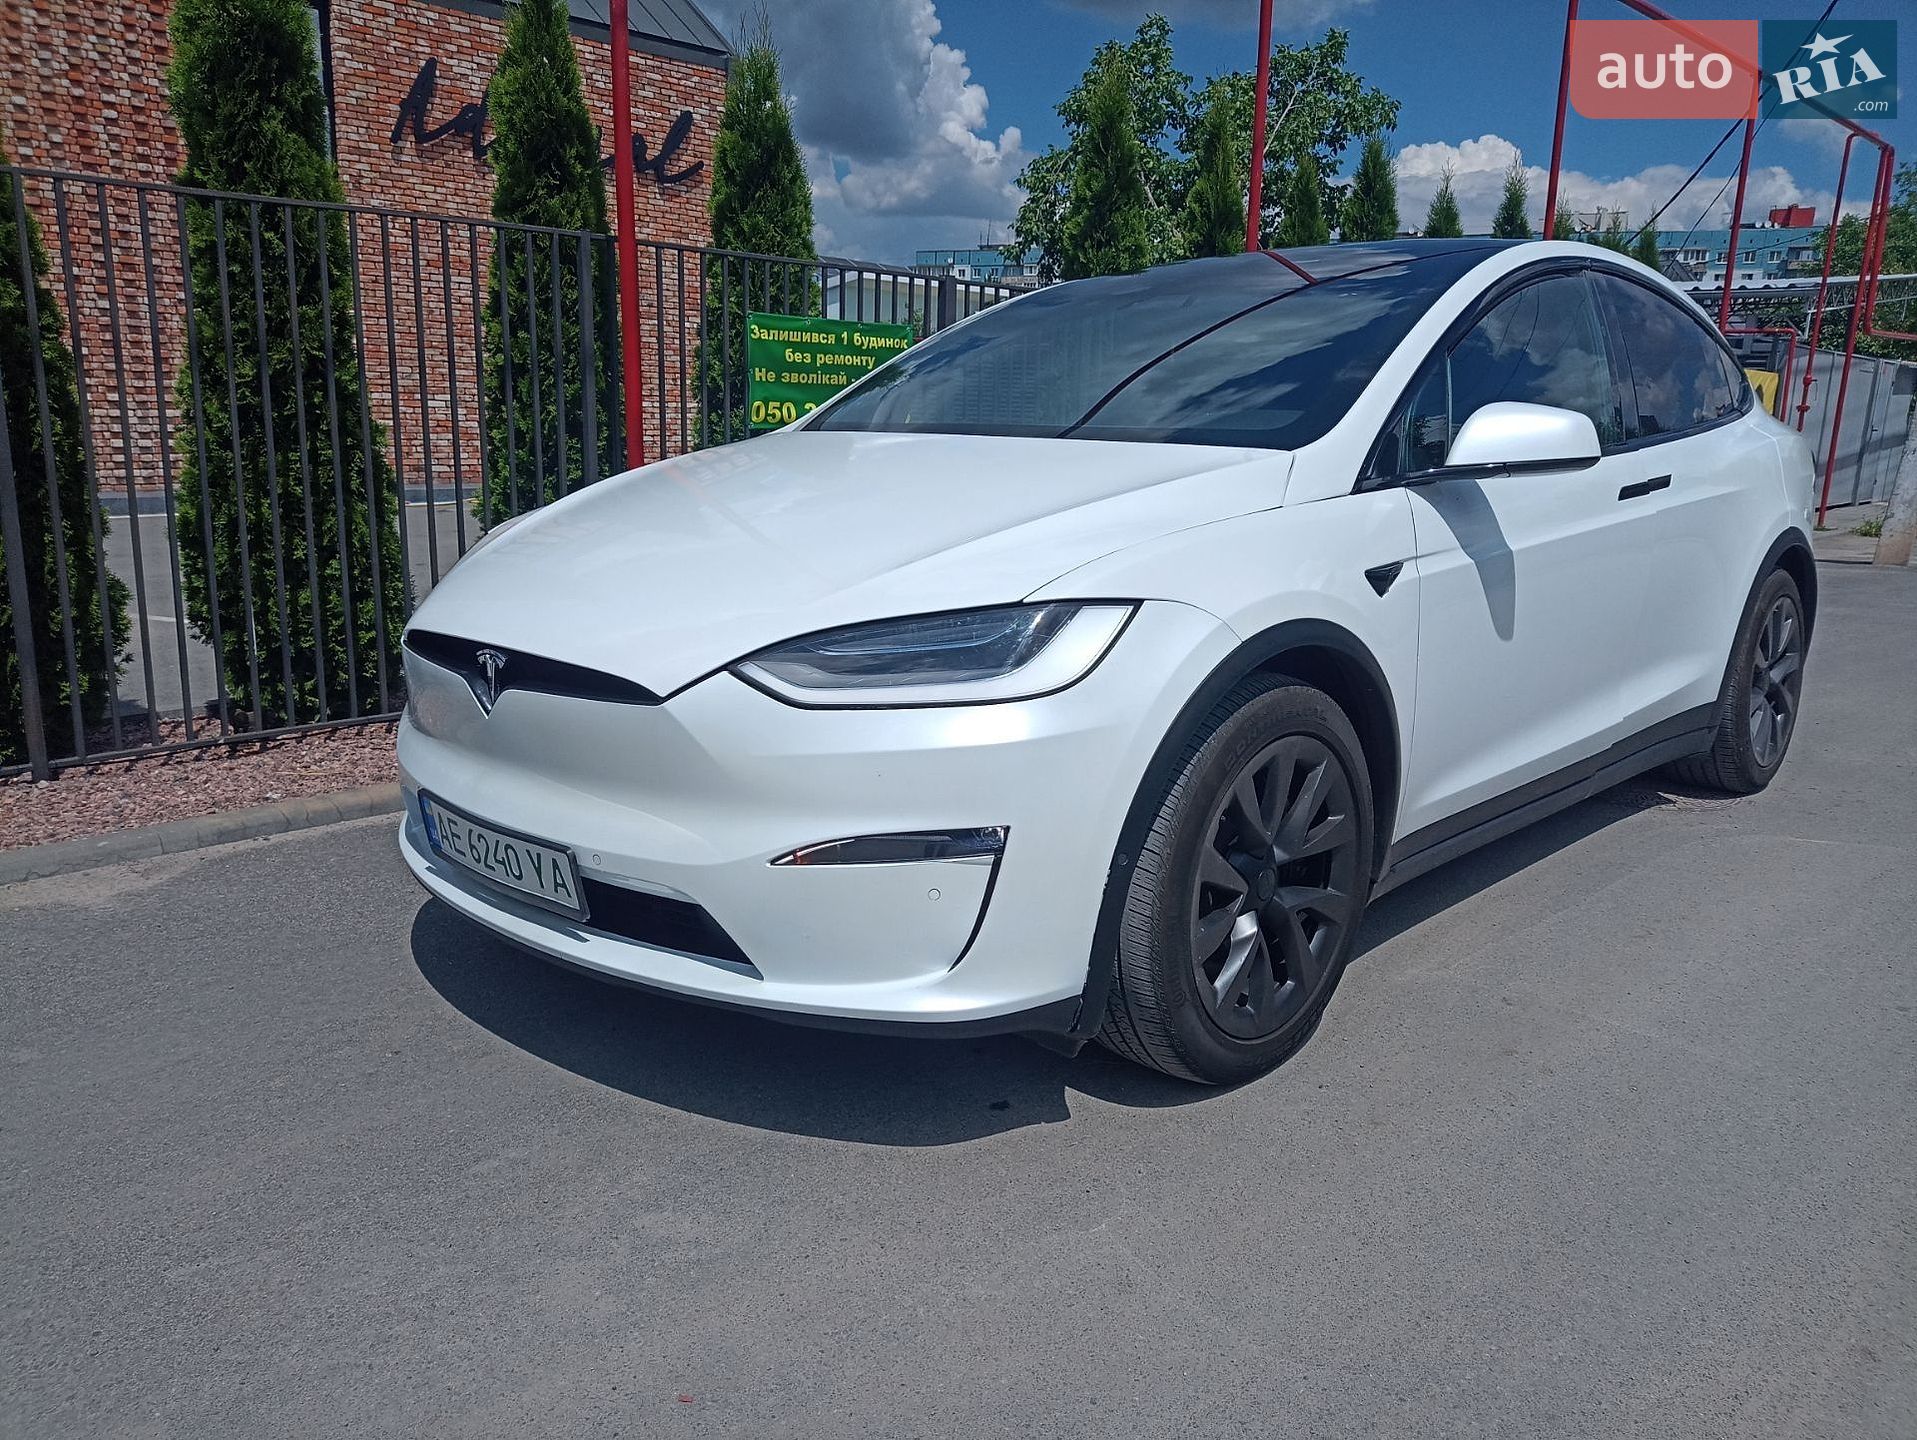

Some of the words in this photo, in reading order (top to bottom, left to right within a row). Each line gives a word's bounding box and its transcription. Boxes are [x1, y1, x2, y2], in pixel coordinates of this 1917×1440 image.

[751, 325, 835, 344] Залишився
[841, 332, 848, 345] 1
[853, 332, 908, 350] будинок
[785, 348, 812, 363] без
[816, 353, 876, 369] ремонту
[755, 368, 776, 382] Не
[781, 371, 847, 385] зволікай
[751, 401, 797, 423] 050
[438, 812, 466, 858] AE
[468, 828, 524, 881] 6240
[526, 849, 572, 898] YA
